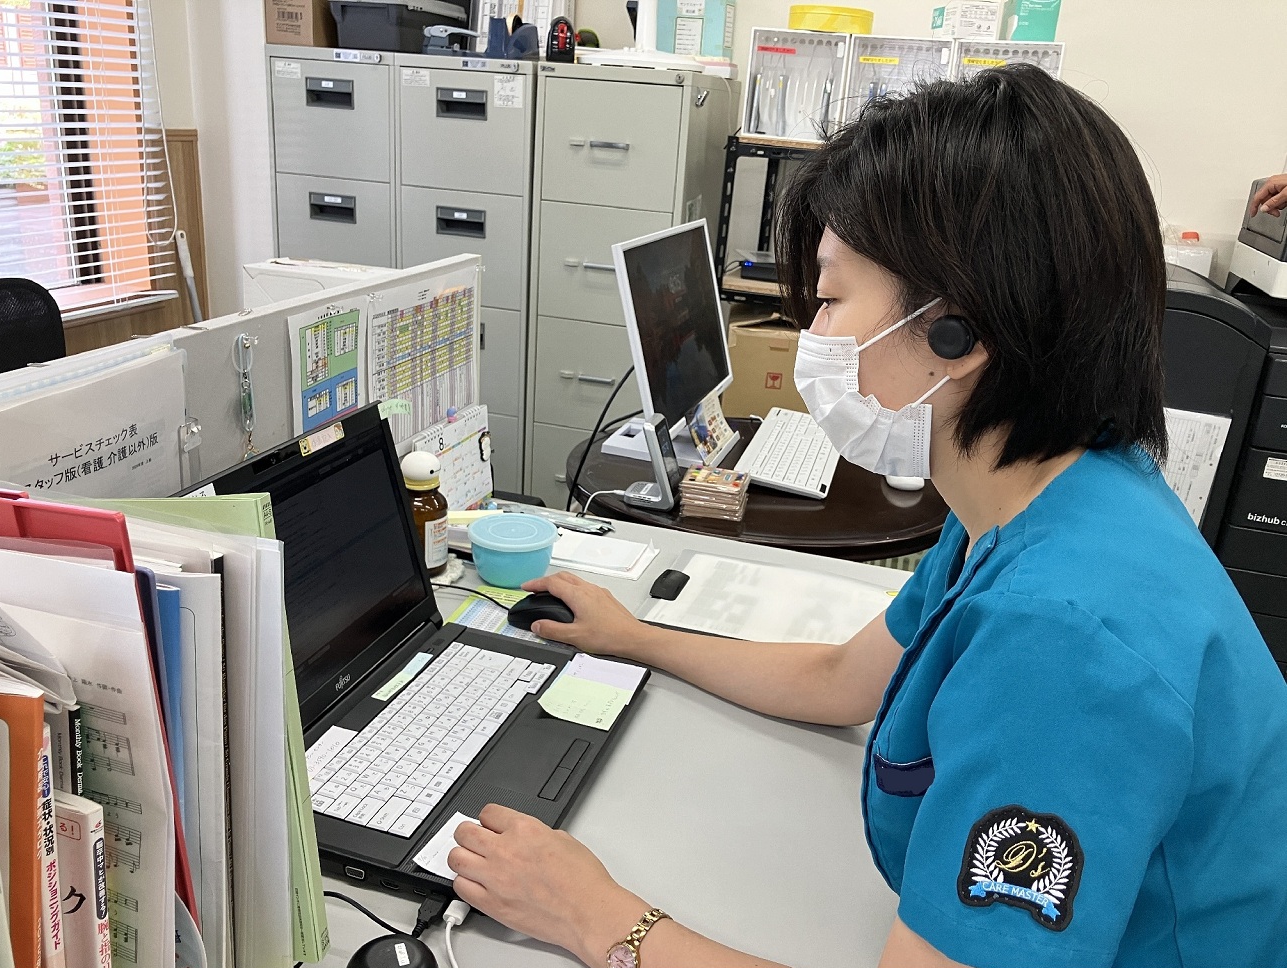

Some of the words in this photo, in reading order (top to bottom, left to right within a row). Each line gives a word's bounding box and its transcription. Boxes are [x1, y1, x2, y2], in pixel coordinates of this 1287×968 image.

[47, 423, 138, 468] サービスチェック表
[439, 437, 444, 451] 8
[1247, 512, 1280, 525] bizhub
[335, 673, 351, 692] FUJITSU
[74, 718, 82, 747] Monthly
[75, 749, 83, 768] Book
[45, 859, 62, 950] ポジショニングガイド
[982, 882, 1010, 894] CARE
[1011, 886, 1049, 908] MASTER
